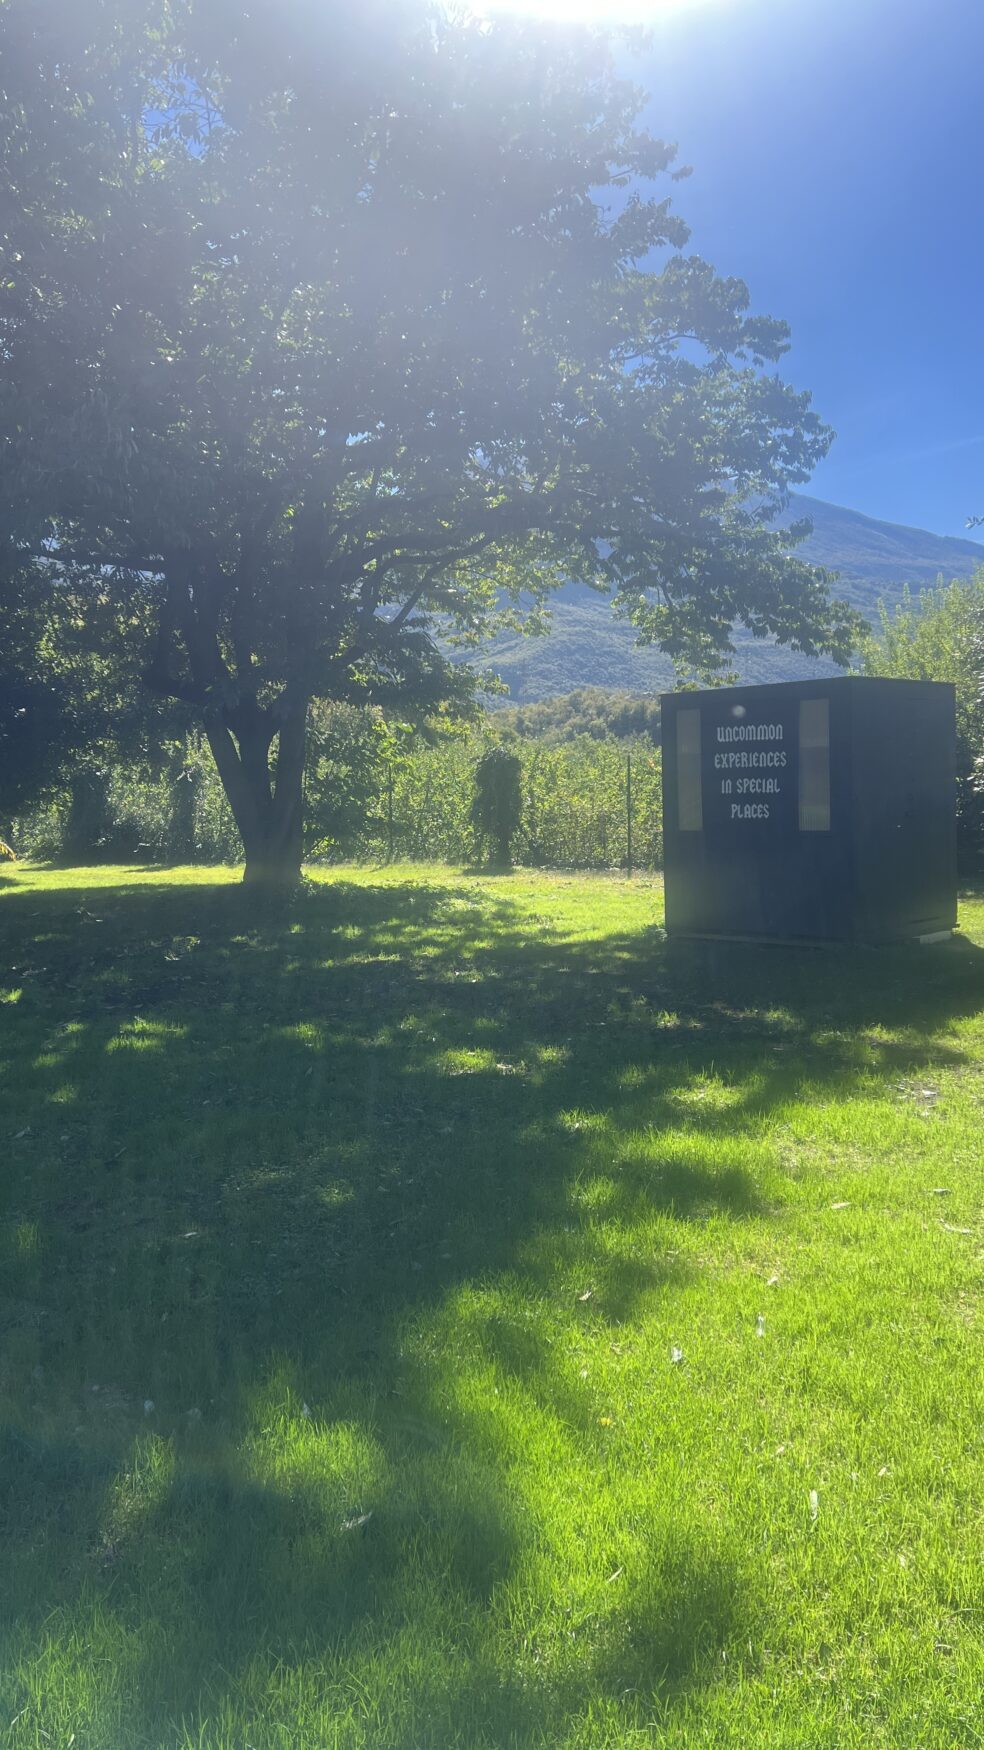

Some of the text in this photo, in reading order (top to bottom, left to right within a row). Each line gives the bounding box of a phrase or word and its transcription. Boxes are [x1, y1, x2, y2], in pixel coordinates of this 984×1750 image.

[717, 724, 783, 742] UNCOMMON
[714, 751, 787, 768] EXPERIENCES
[721, 778, 781, 794] IN SPECIAL
[731, 804, 770, 819] PLACES
